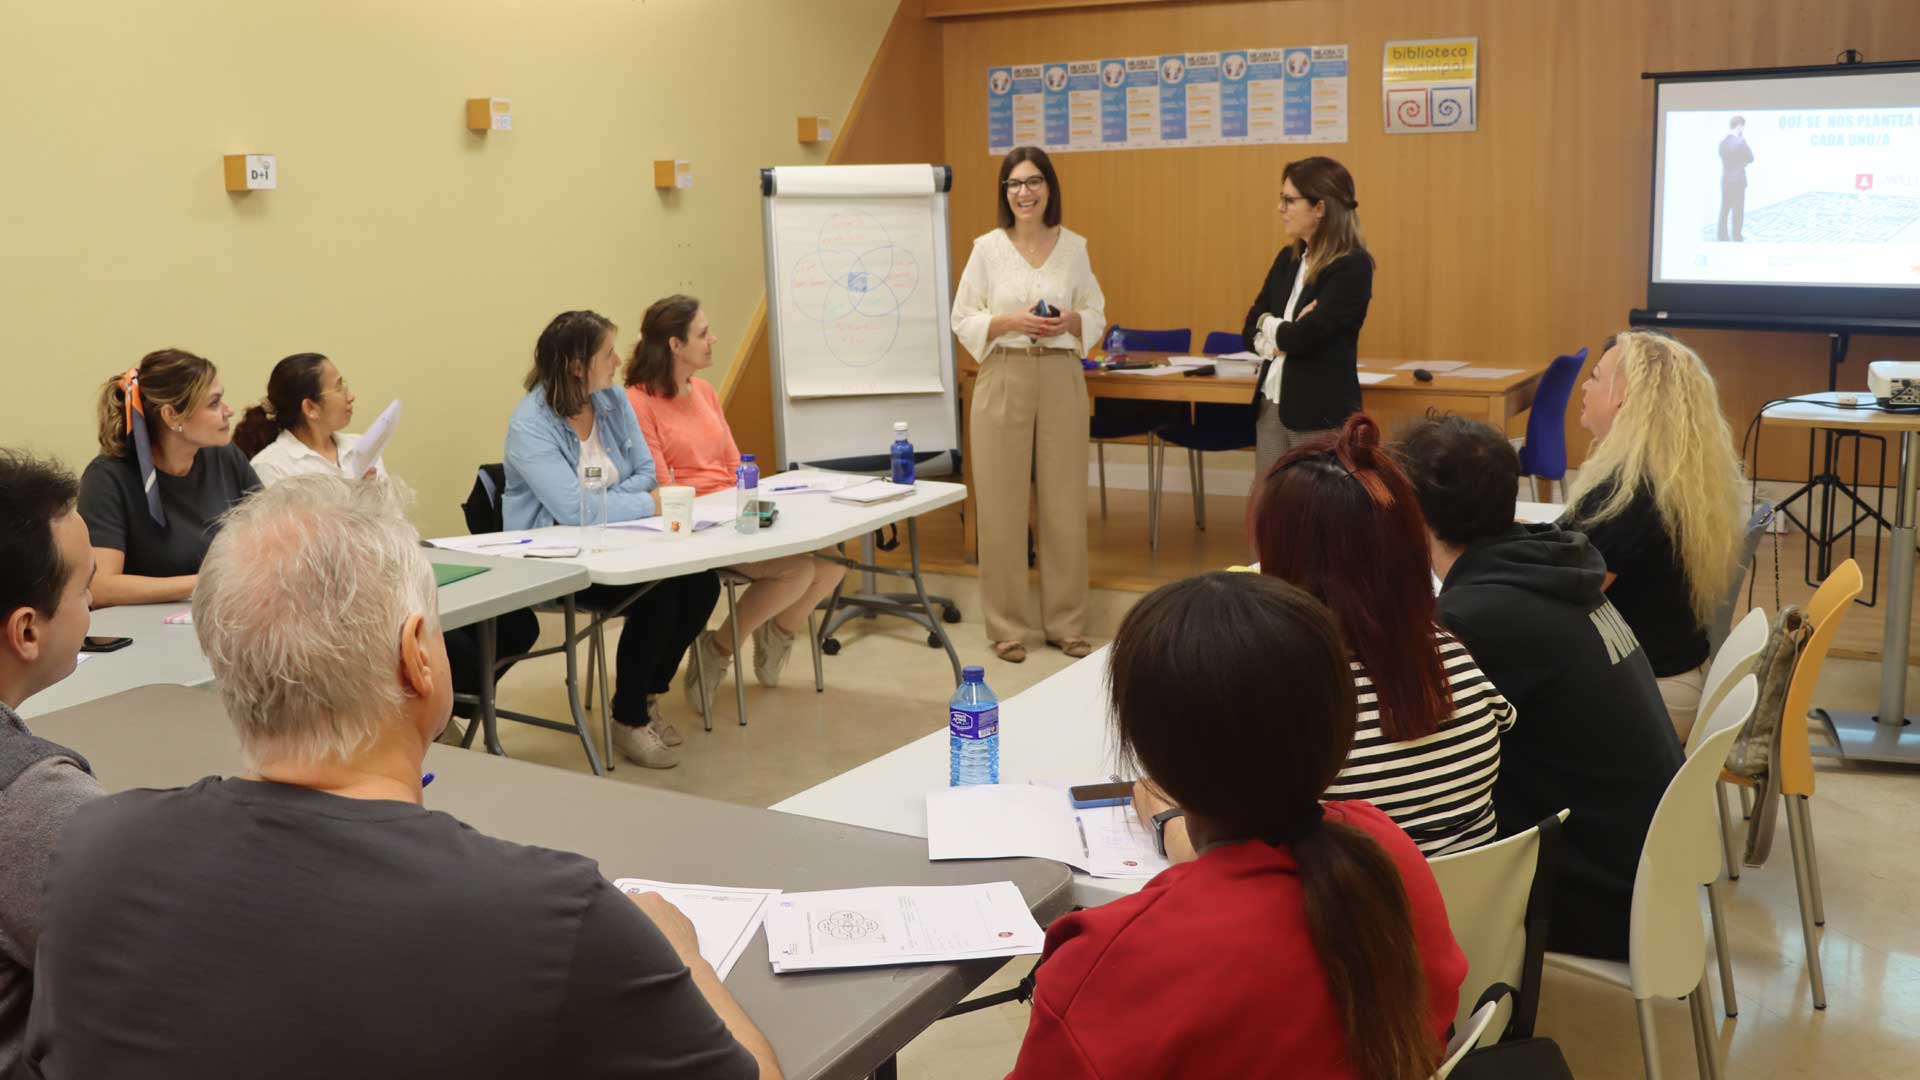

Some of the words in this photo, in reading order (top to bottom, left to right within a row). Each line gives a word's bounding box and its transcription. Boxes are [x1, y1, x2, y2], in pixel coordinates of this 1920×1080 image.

[1392, 46, 1468, 59] biblioteca
[1828, 114, 1854, 128] NOS
[1857, 113, 1914, 128] PLANTEA
[1810, 133, 1845, 146] CADA
[1848, 133, 1890, 146] UNO/A
